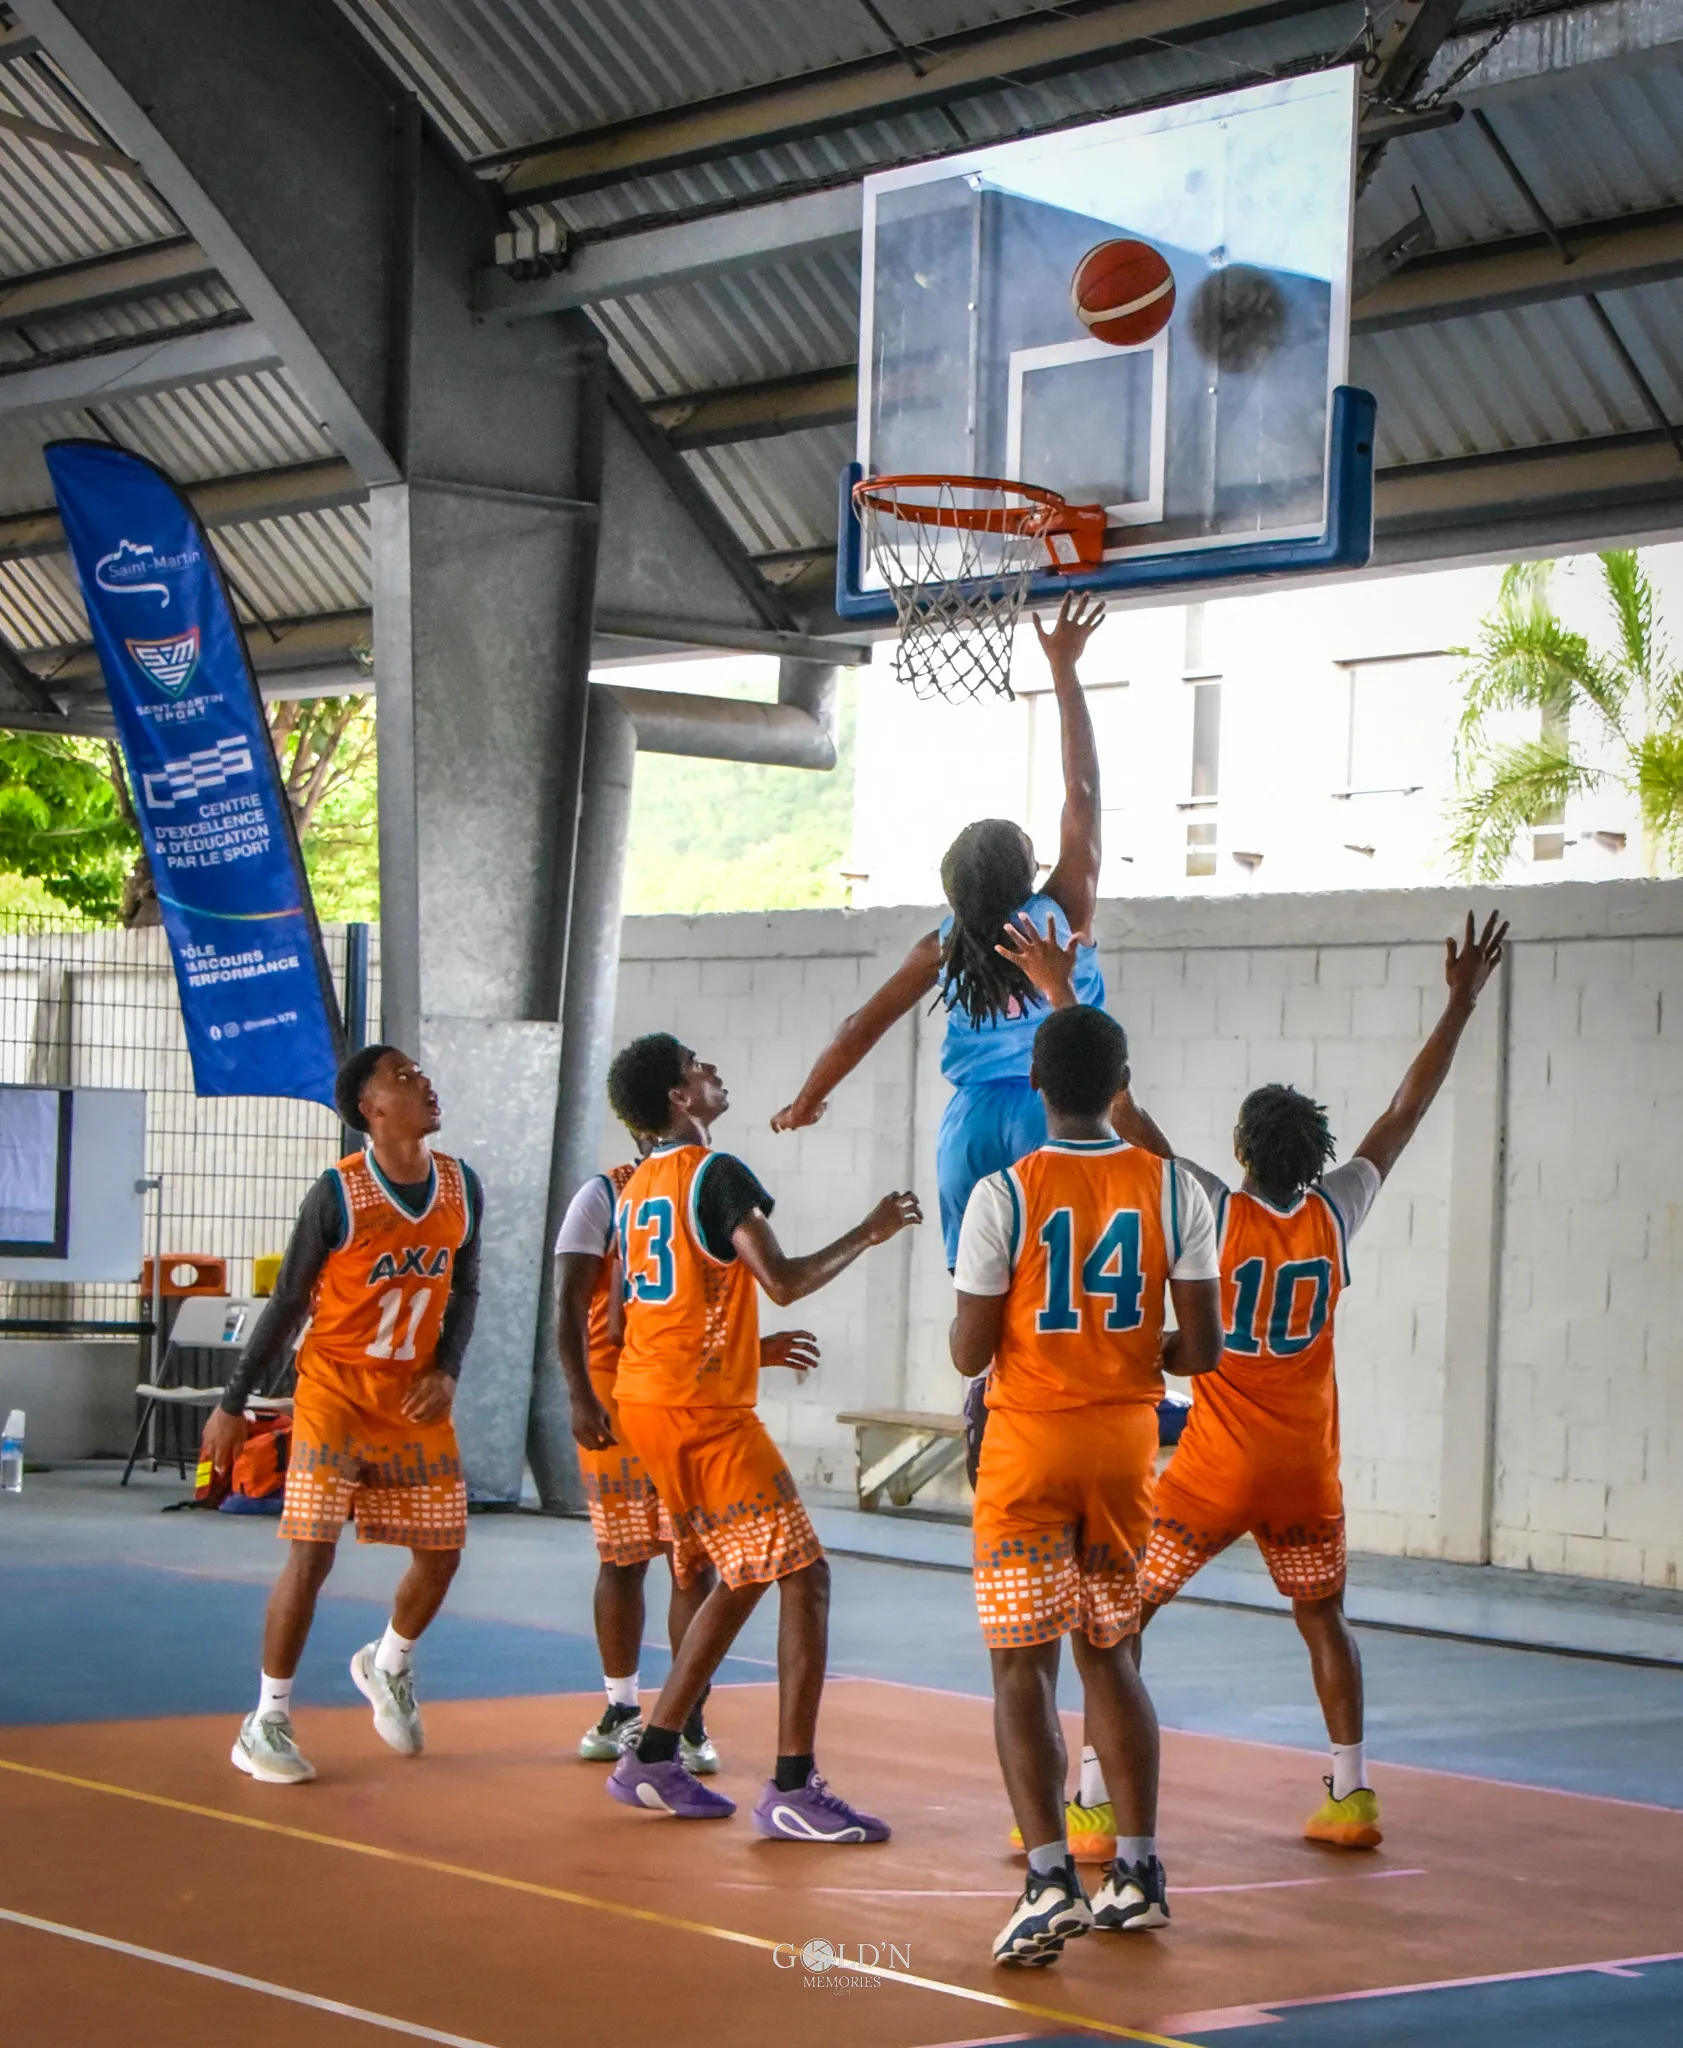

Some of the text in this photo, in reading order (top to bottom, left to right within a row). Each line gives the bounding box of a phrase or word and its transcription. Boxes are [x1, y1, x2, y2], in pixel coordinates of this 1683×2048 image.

[108, 550, 201, 578] Saint-Martin
[199, 793, 262, 818] CENTRE
[155, 809, 265, 840] D'EXCELLENCE
[155, 840, 168, 855] &
[167, 838, 271, 868] PAR LE SPORT
[366, 1244, 449, 1287] AXA
[616, 1196, 676, 1306] 13
[1035, 1206, 1147, 1334] 14
[365, 1287, 433, 1361] 11
[1223, 1256, 1333, 1357] 10
